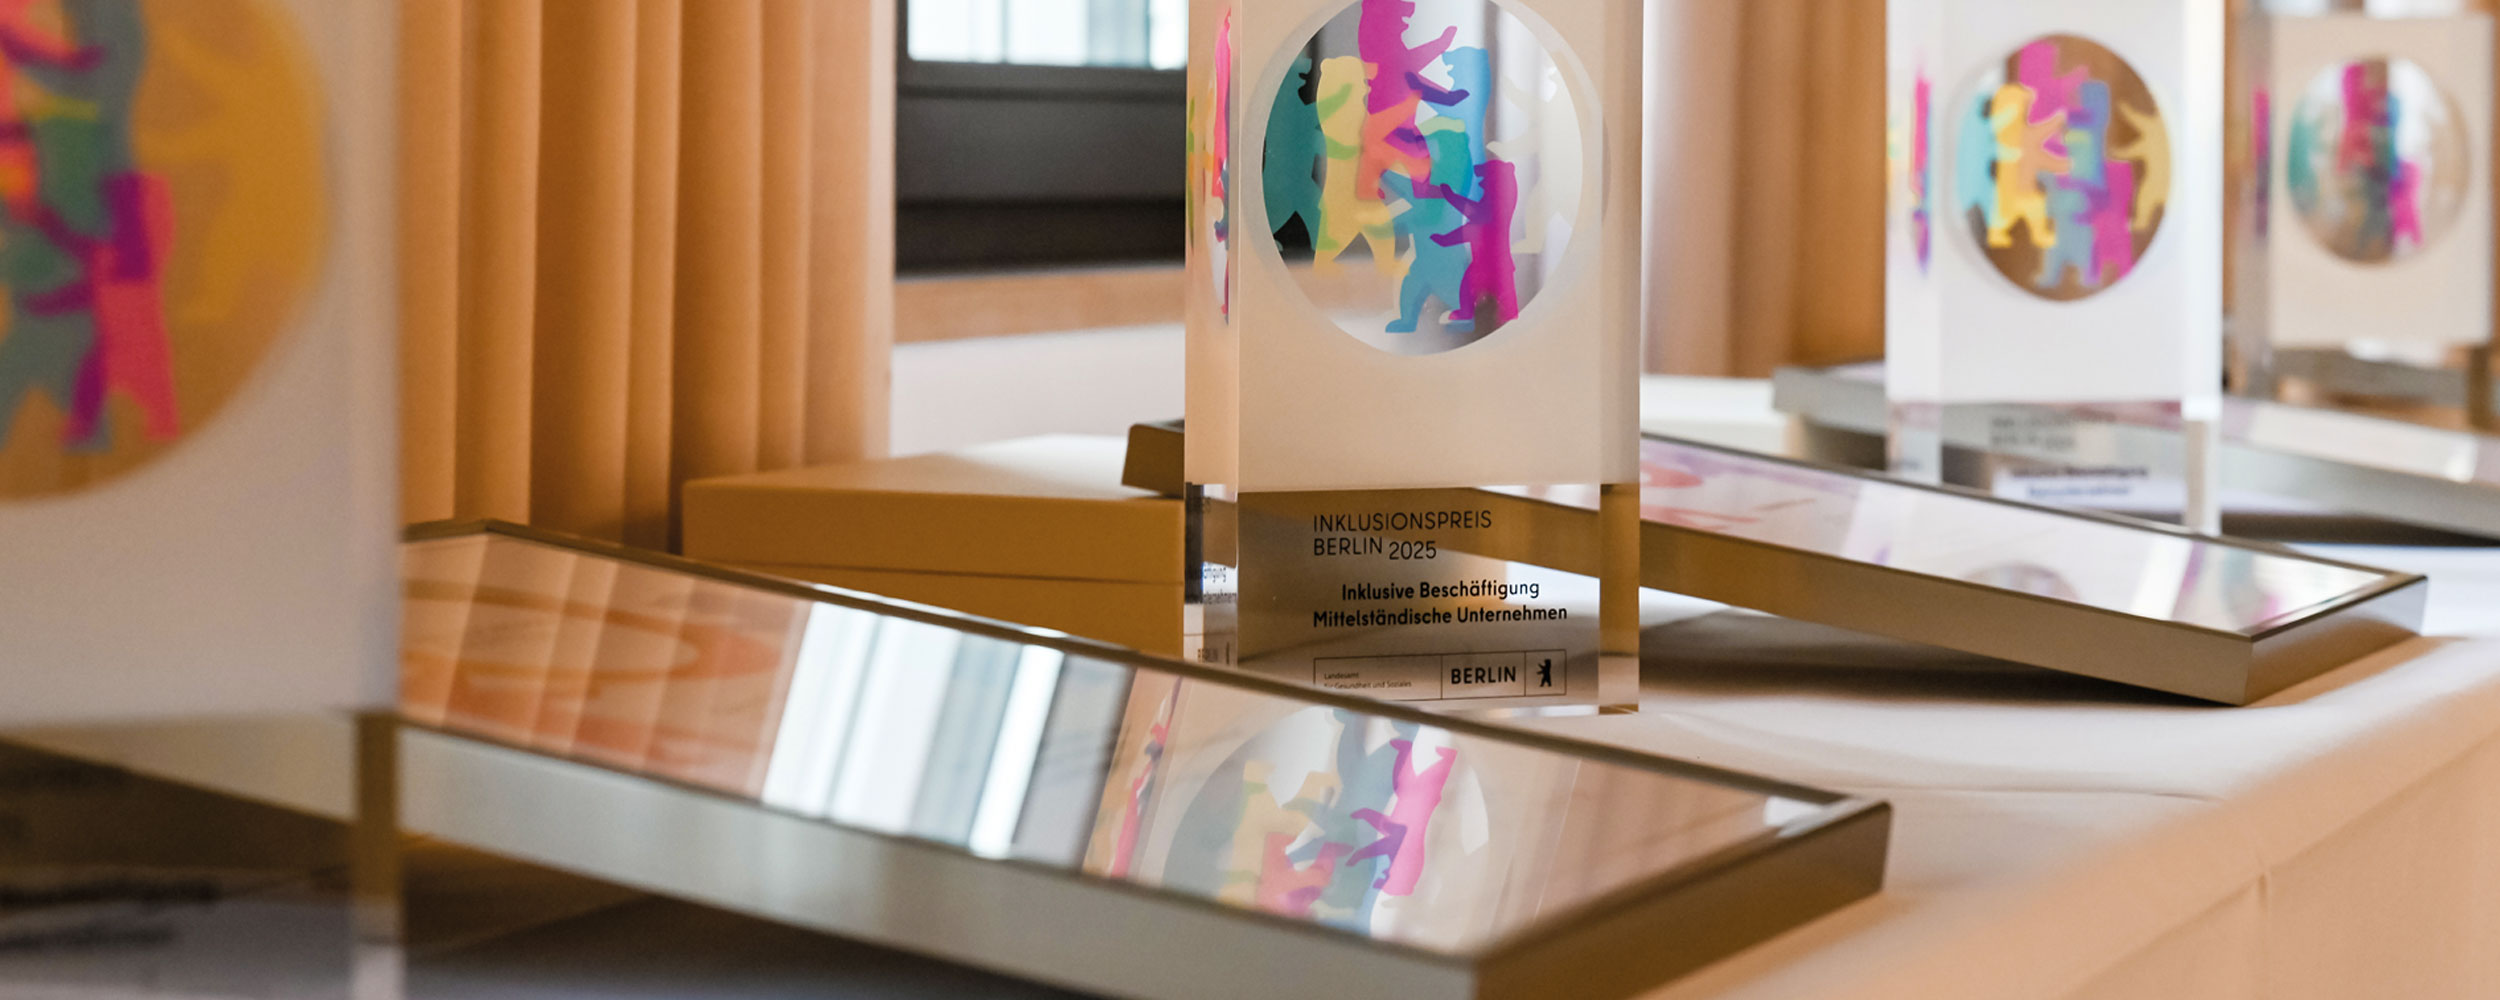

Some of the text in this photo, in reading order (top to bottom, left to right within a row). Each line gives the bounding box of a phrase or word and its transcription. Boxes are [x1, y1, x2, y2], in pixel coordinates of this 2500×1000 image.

[1313, 510, 1492, 532] INKLUSIONSPREIS
[1313, 537, 1437, 560] BERLIN 2025
[1341, 579, 1540, 601] Inklusive Beschäftigung
[1313, 605, 1568, 628] Mittelständische Unternehmen
[1450, 666, 1517, 685] BERLIN
